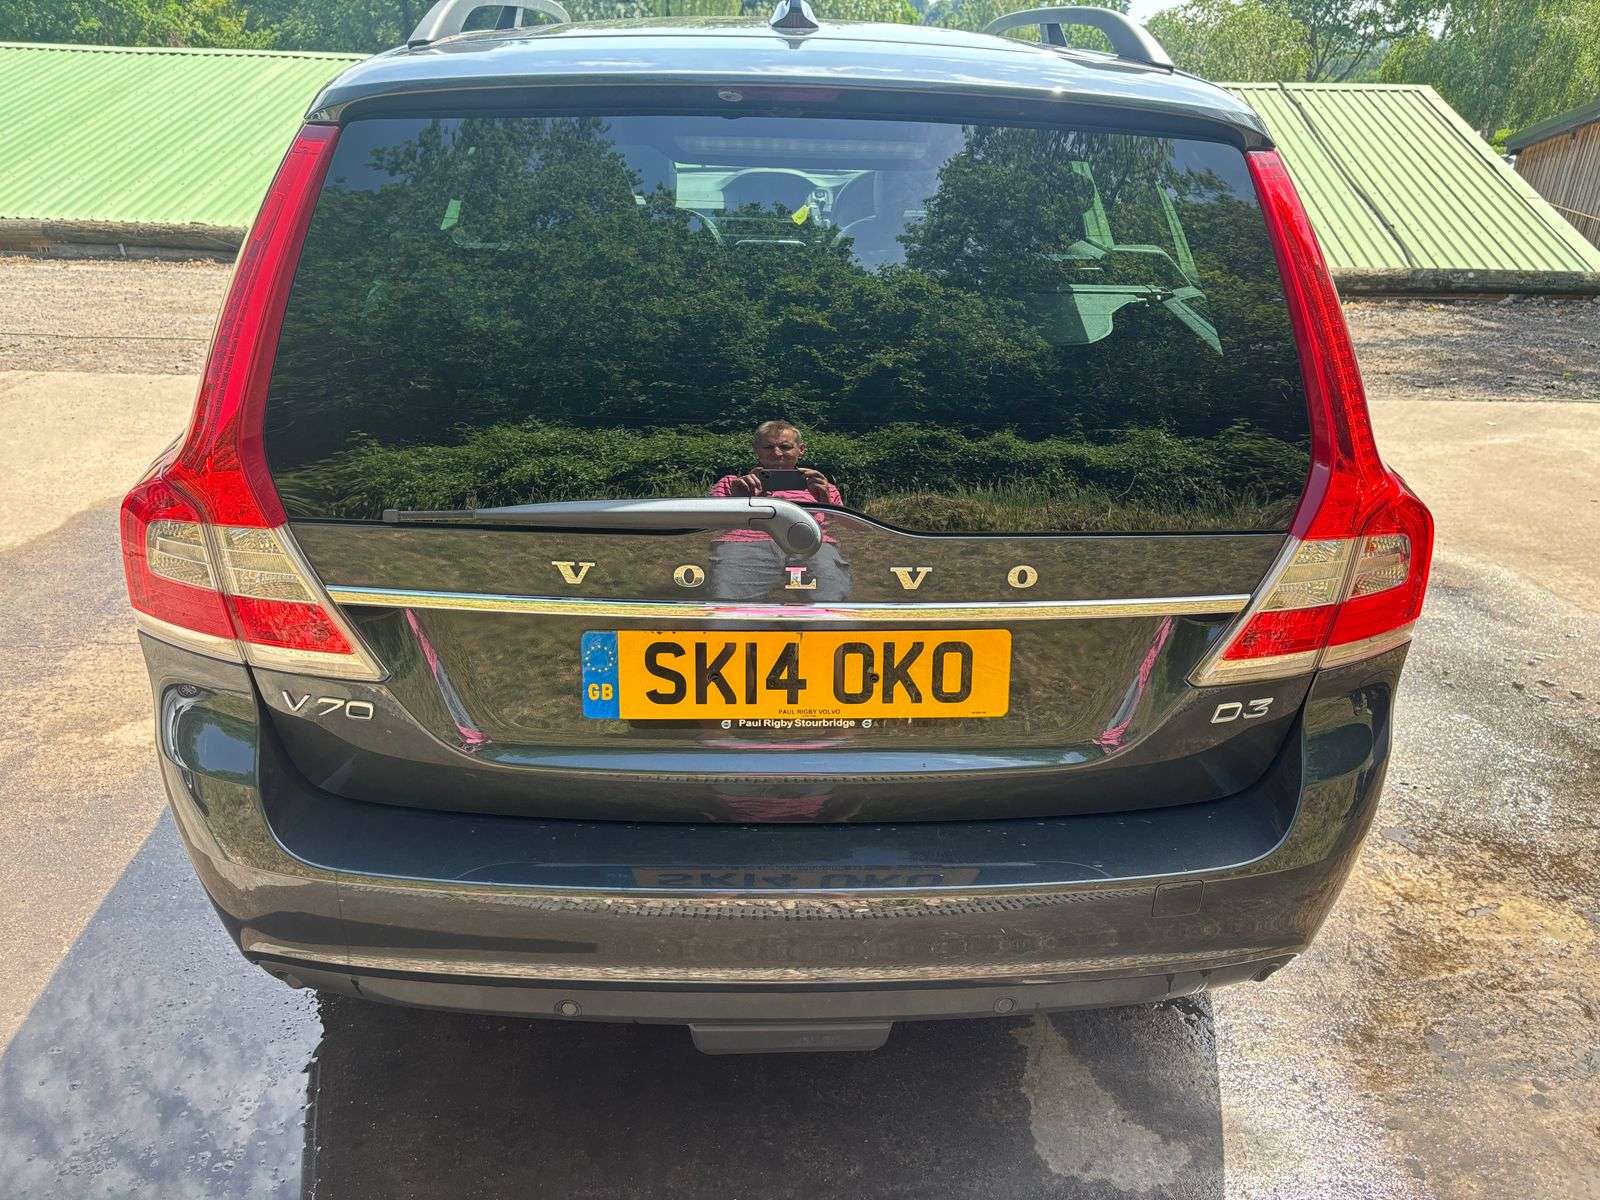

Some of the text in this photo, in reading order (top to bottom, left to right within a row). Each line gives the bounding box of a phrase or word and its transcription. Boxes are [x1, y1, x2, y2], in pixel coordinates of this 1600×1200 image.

[551, 560, 1039, 590] VOLVO
[644, 641, 973, 704] SK14 OKO
[281, 689, 375, 720] V70
[587, 683, 613, 700] GB
[738, 718, 856, 729] Paul Rigby Stourbridge
[1209, 697, 1274, 724] D3
